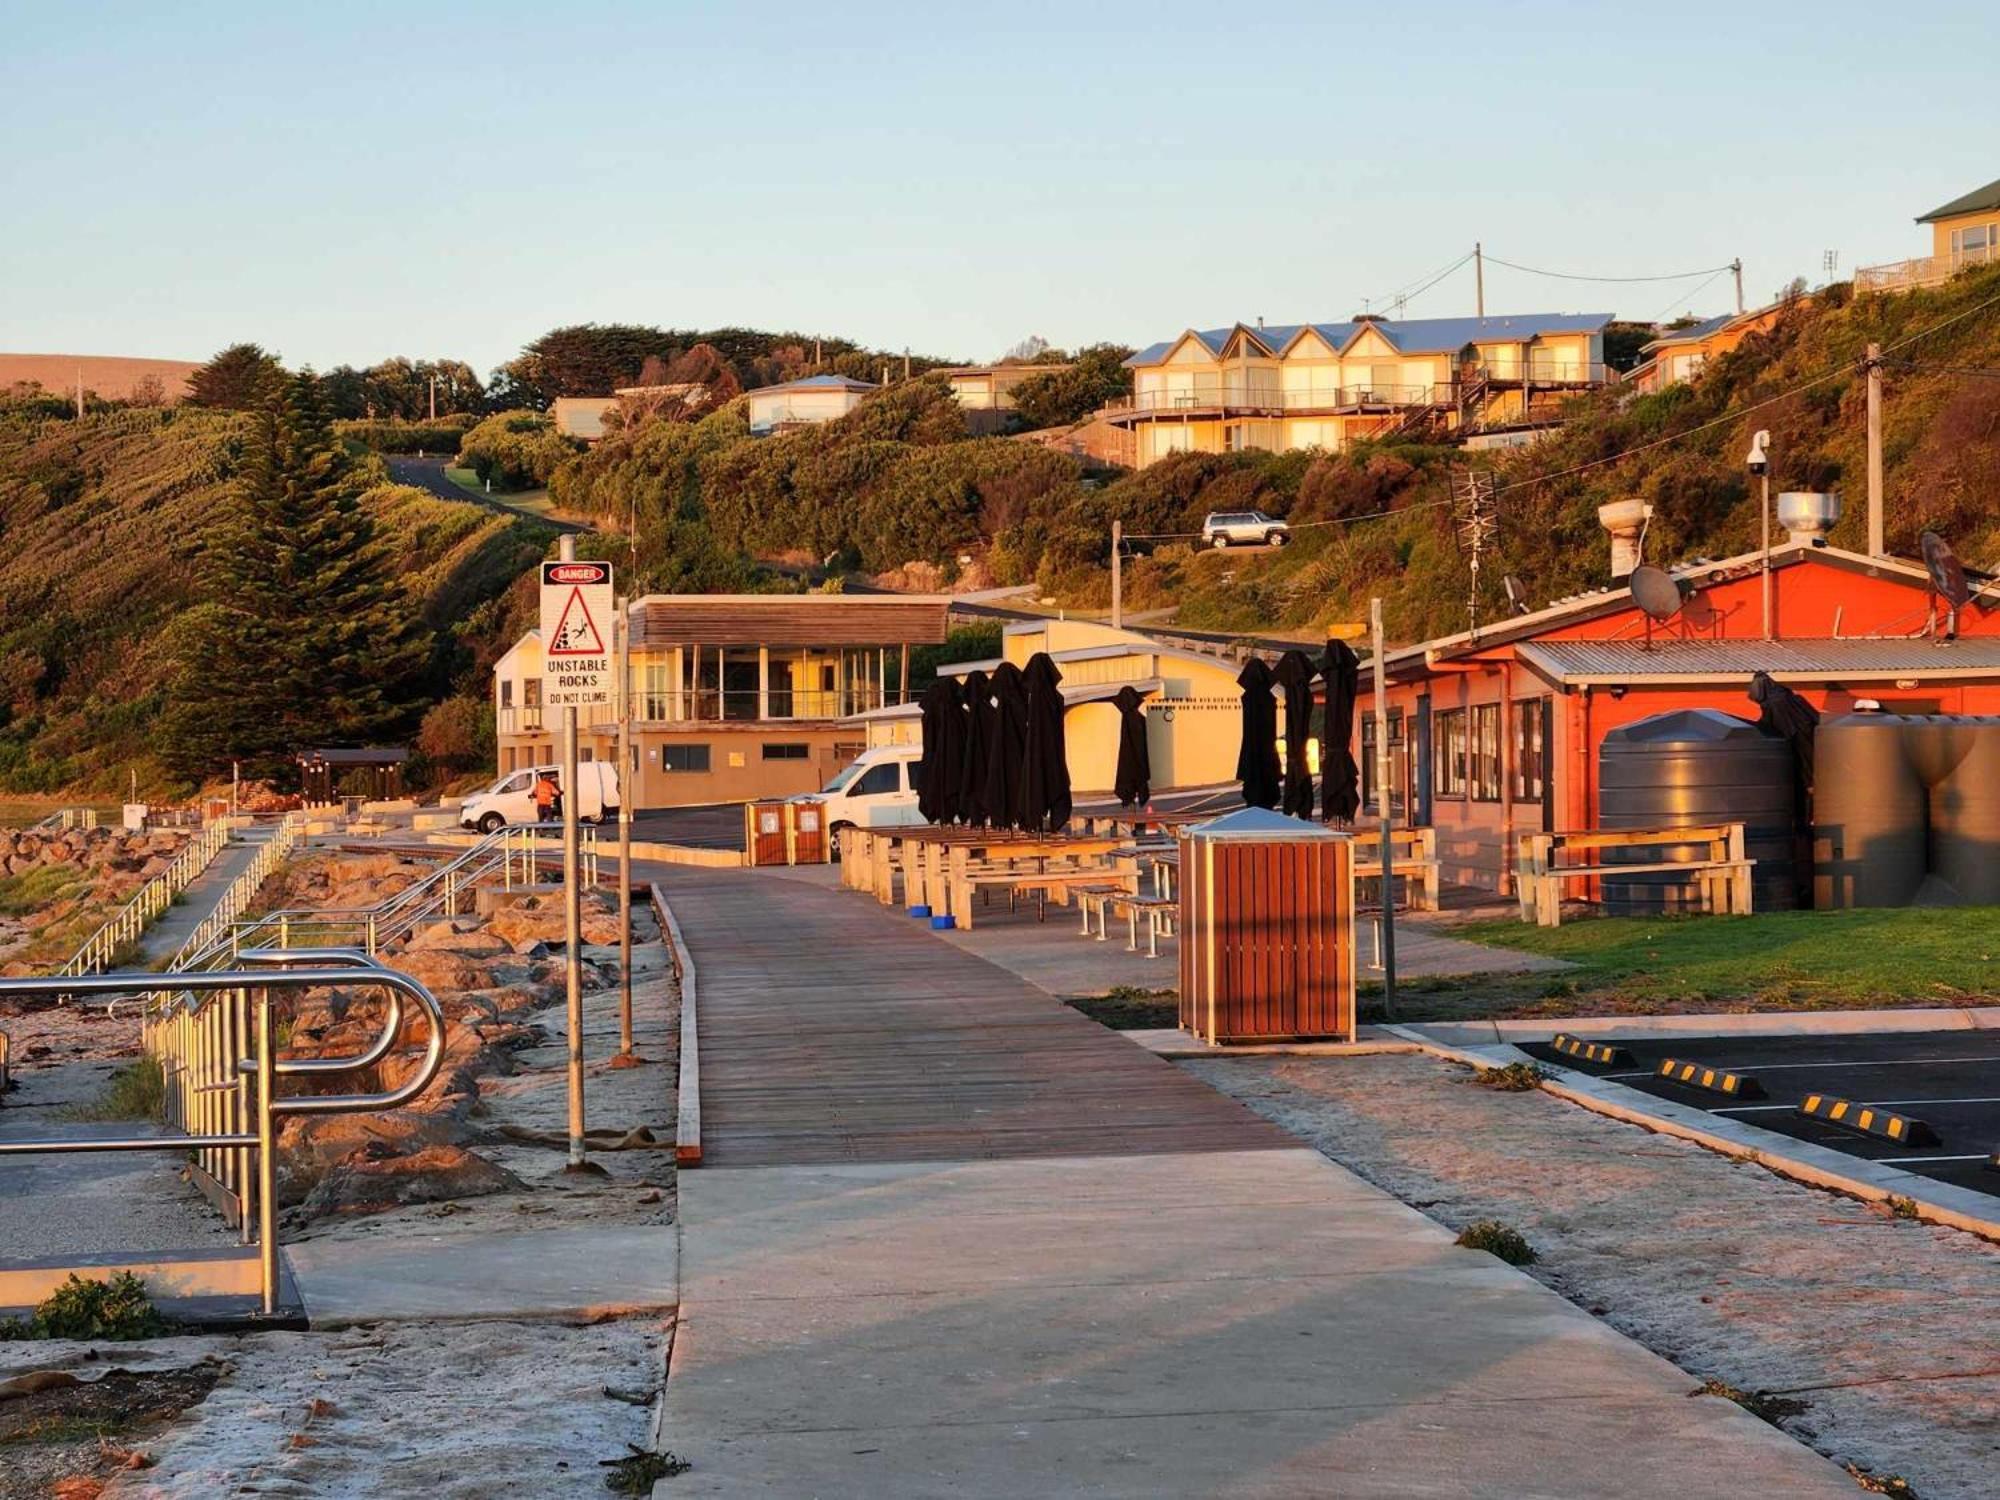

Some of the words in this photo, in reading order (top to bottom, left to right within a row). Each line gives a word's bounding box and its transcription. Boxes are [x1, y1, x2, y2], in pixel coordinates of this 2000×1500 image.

[558, 569, 597, 580] DANGER
[548, 660, 608, 672] UNSTABLE
[559, 675, 598, 687] ROCKS
[550, 694, 561, 704] DO
[563, 693, 578, 703] NOT
